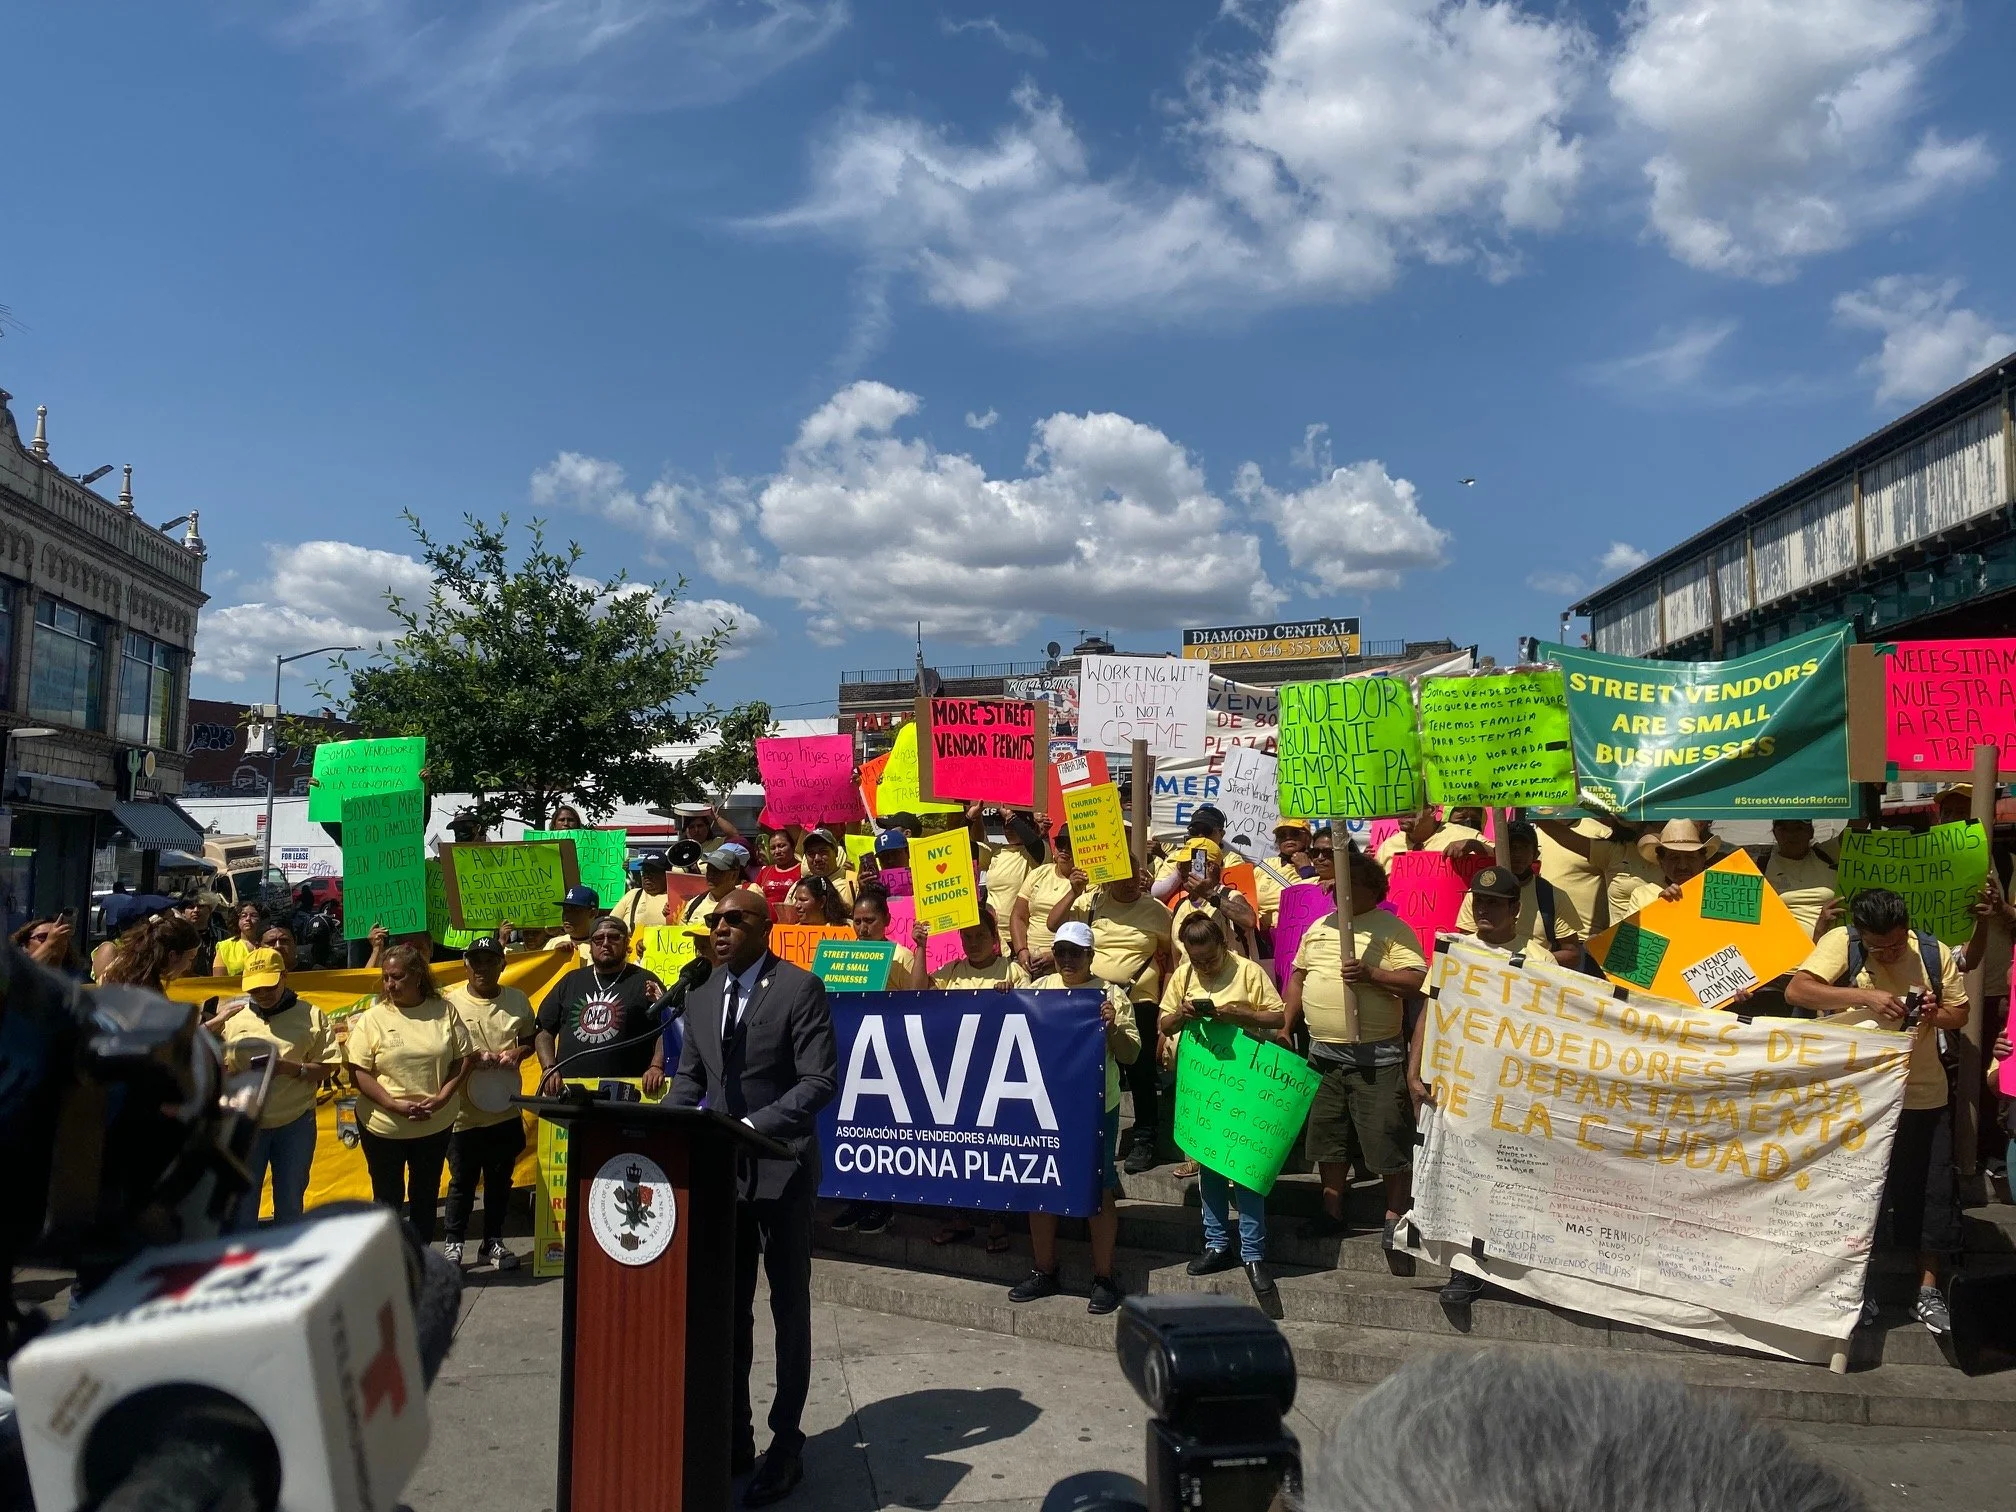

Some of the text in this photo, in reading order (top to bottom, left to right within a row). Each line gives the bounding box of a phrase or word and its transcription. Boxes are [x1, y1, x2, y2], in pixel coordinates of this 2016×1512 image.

[1193, 621, 1350, 645] DIAMOND CENTRAL
[1194, 645, 1252, 660] OSHA
[1086, 658, 1204, 683] WORKING WITH
[1569, 657, 1820, 704] STREET VENDORS
[1096, 682, 1183, 705] DIGNITY
[1892, 678, 2016, 708] NUESTRA
[855, 712, 893, 732] TAE
[931, 699, 978, 727] MORE
[979, 700, 1035, 728] STREET
[1115, 705, 1175, 720] IS NOT A
[1611, 703, 1771, 735] ARE SMALL
[1897, 708, 1983, 736] AREA
[934, 732, 987, 759] VENDOR
[991, 732, 1034, 761] PERMITS
[1100, 720, 1189, 750] CRIME
[758, 741, 793, 770] Tengo
[834, 752, 851, 770] por
[1595, 736, 1776, 768] BUSINESSES
[1234, 753, 1260, 781] Let
[1384, 748, 1413, 784] PA
[790, 769, 832, 792] trabajar
[343, 796, 391, 822] SOMOS
[1071, 796, 1103, 809] CHURROS
[1290, 781, 1416, 816] ADELANTE!
[1734, 795, 1848, 807] #StreetVendorReform
[1072, 810, 1098, 820] MOMOS
[345, 830, 359, 847] DE
[365, 825, 379, 843] 80
[1074, 822, 1096, 832] KEBAB
[1076, 833, 1097, 843] HALAL
[281, 852, 309, 860] FOR LEASE
[927, 845, 953, 861] NYC
[1078, 843, 1109, 854] RED TAPE
[345, 847, 418, 876] SIN PODER
[1080, 855, 1107, 866] TICKETS
[1840, 858, 1954, 885] TRABAJAR
[925, 875, 962, 892] STREET
[1705, 872, 1763, 888] DIGNITY
[461, 885, 556, 906] DE VENDEDORES
[922, 887, 969, 906] VENDORS
[466, 902, 551, 921] AMBULANTES
[1702, 899, 1756, 917] JUSTICE
[345, 916, 367, 937] POR
[822, 950, 885, 961] STREET VENDORS
[1637, 935, 1666, 985] VENDOR
[1683, 944, 1742, 982] I'M VENDOR
[824, 974, 868, 984] BUSINESSES
[830, 963, 870, 972] ARE SMALL
[1705, 962, 1732, 983] NOT
[1698, 966, 1756, 1004] CRIMINAL
[1440, 956, 1825, 1067] PETICIONES DE
[1435, 1002, 1863, 1116] VENDEDORES PARA
[837, 1013, 1059, 1131] AVA
[1189, 1059, 1292, 1112] muchos años
[1430, 1039, 1868, 1152] EL DEPARTAMENTO
[1229, 1106, 1247, 1120] en
[1491, 1094, 1553, 1140] LA
[836, 1126, 1060, 1149] ASOCIACIÓN DE VENDEDORES AMBULANTES
[1222, 1126, 1274, 1160] agencias
[835, 1143, 1062, 1187] CORONA PLAZA
[1224, 1149, 1236, 1169] la
